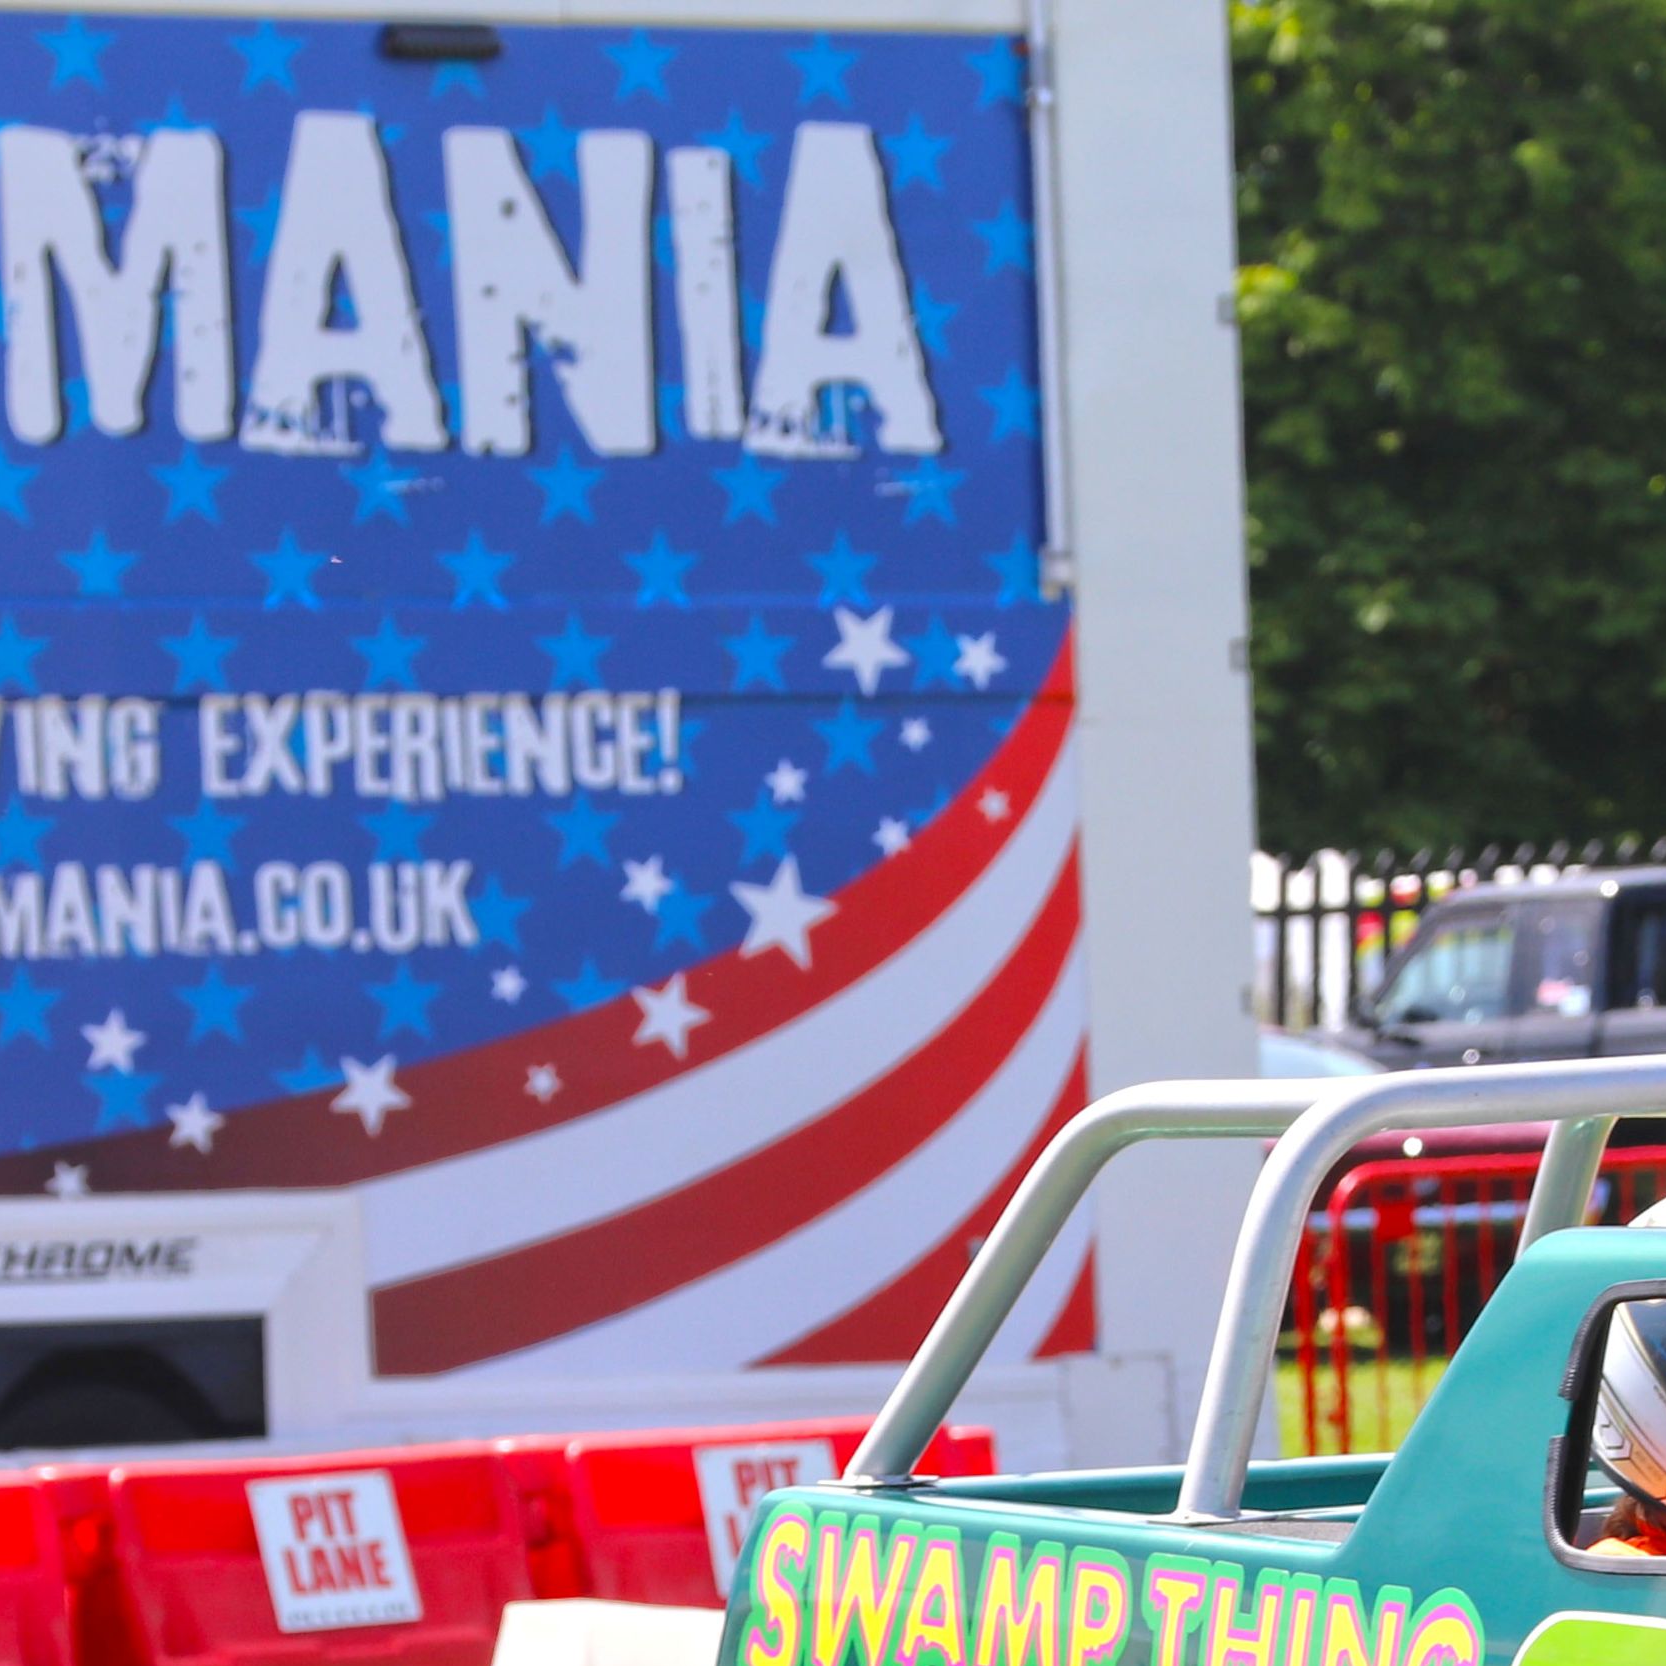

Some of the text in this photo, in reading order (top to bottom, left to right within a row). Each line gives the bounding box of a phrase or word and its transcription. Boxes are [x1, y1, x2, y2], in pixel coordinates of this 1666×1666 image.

[198, 687, 684, 800] EXPERIENCE!
[734, 1459, 799, 1507] PIT
[289, 1489, 355, 1540] PIT
[285, 1540, 393, 1596] LANE
